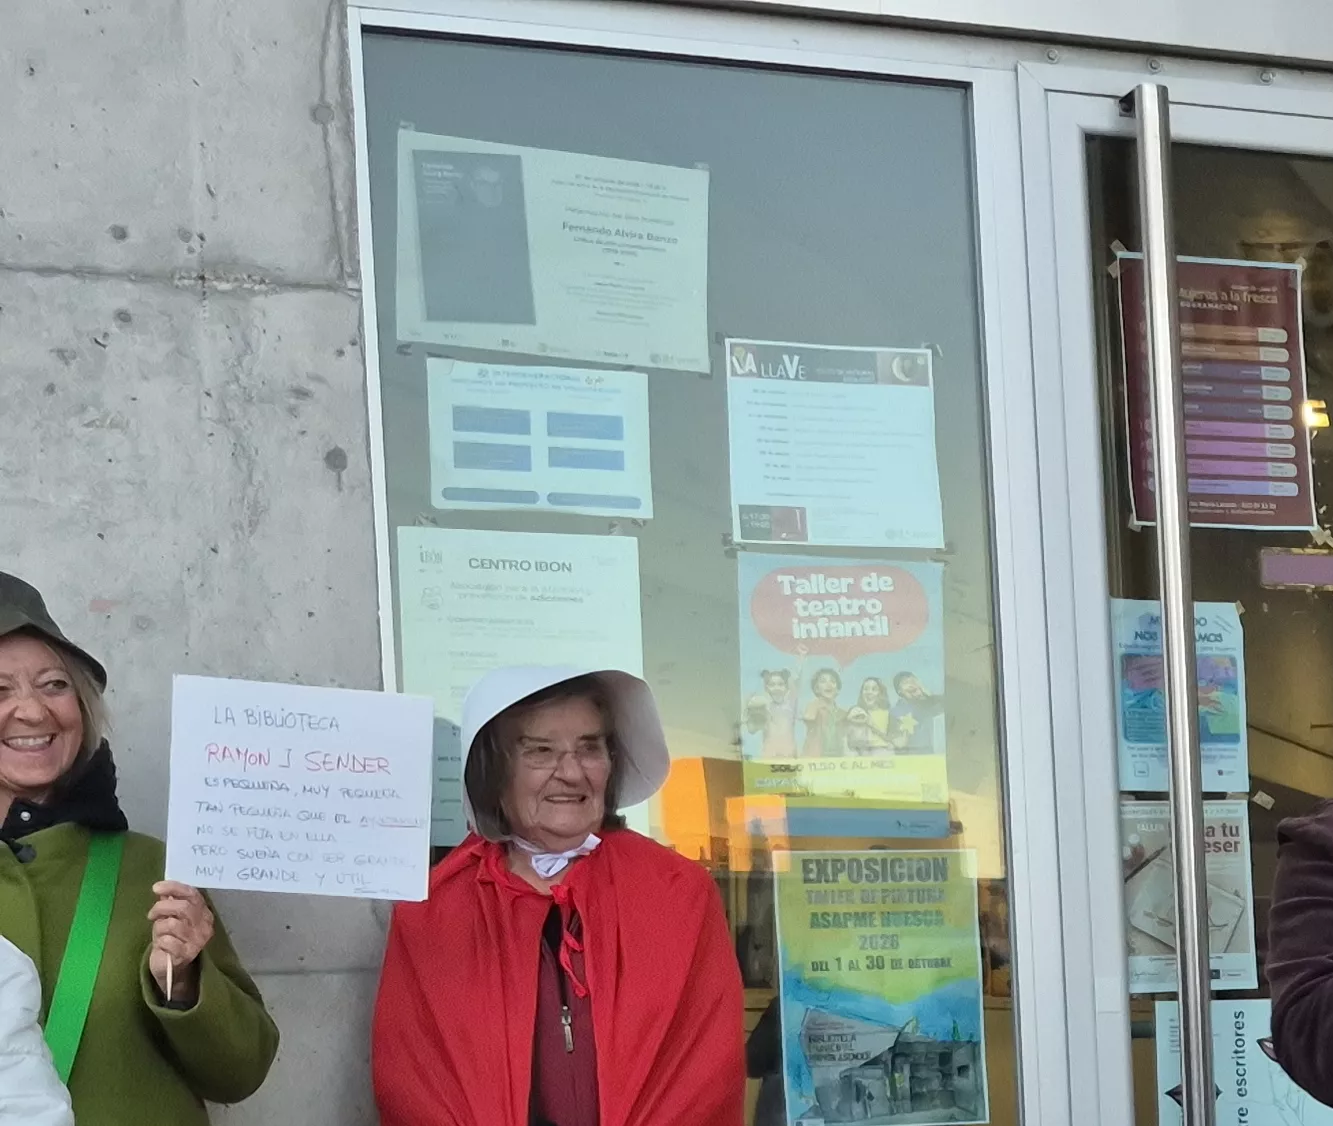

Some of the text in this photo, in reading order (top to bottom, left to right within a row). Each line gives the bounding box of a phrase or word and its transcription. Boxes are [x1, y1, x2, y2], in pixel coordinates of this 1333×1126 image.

[468, 557, 532, 573] CENTRO
[776, 571, 896, 596] Taller de
[792, 597, 884, 618] teatro
[791, 614, 890, 639] infantil
[214, 704, 341, 733] LA BIBLIOTECA
[304, 750, 393, 776] SENDER
[302, 784, 330, 799] MUY
[194, 800, 224, 814] TAN
[296, 809, 326, 822] QUE
[195, 824, 214, 836] NO
[221, 825, 239, 837] SE
[305, 831, 338, 843] ELLA
[1221, 821, 1241, 838] tu
[191, 843, 229, 857] PERO
[286, 850, 313, 863] CON
[194, 864, 225, 882] MUY
[236, 866, 301, 883] GRANDE
[314, 871, 327, 887] Y
[834, 956, 843, 972] 1
[865, 955, 886, 970] 30
[1230, 1009, 1249, 1099] escritores
